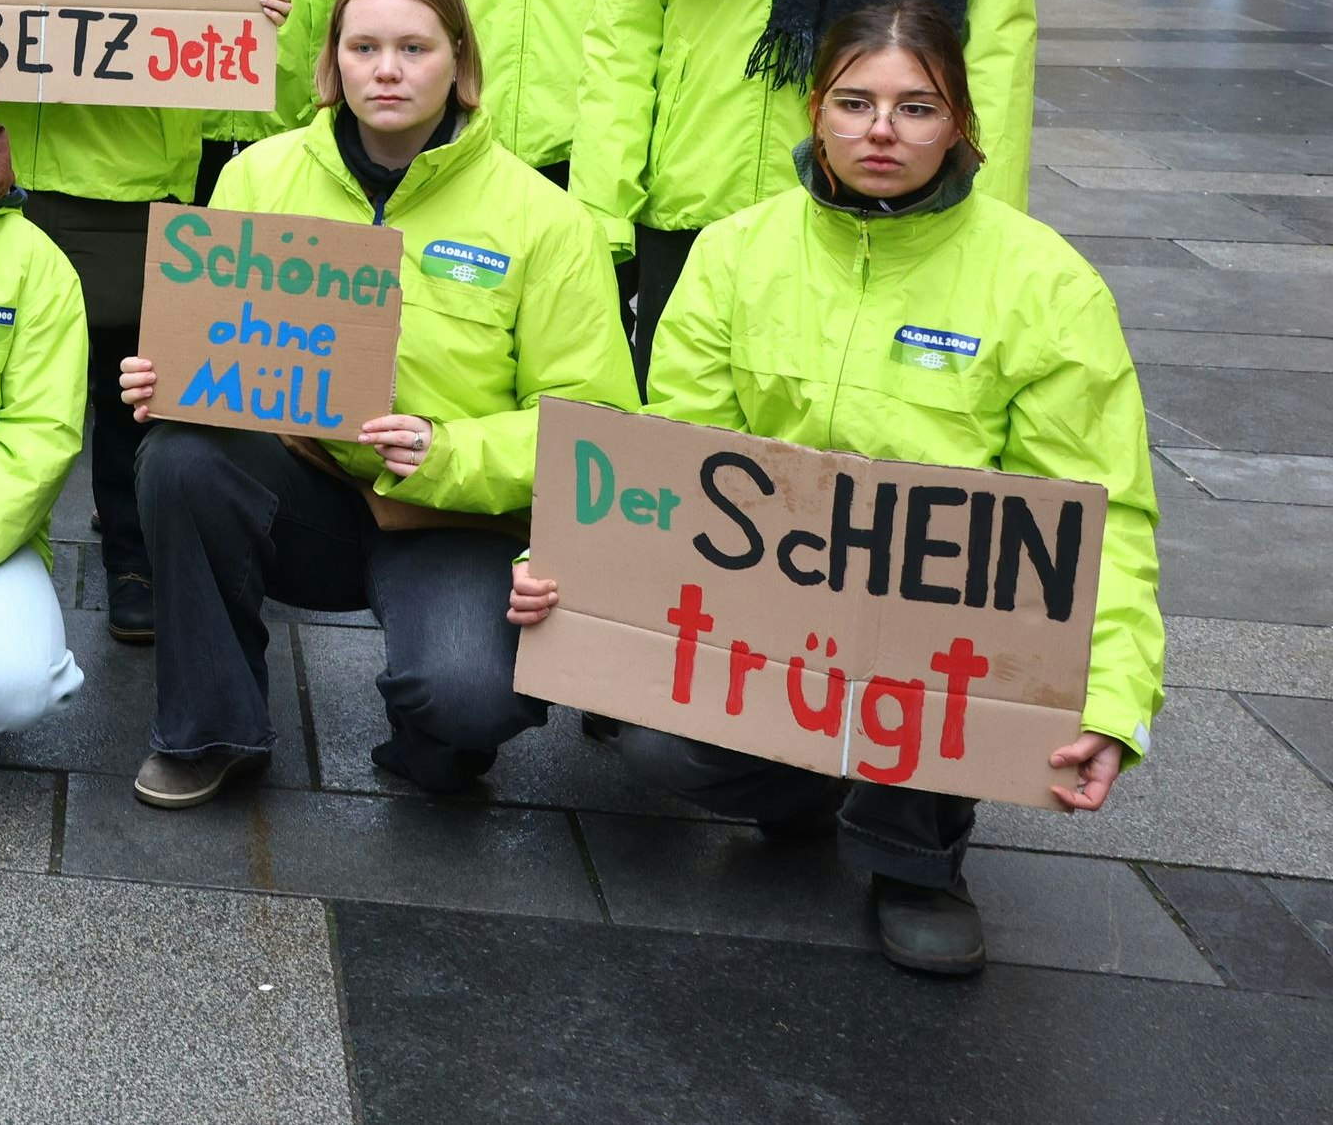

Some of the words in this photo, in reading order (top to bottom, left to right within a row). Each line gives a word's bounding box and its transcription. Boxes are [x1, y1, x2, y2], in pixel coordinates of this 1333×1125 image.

[159, 213, 400, 306] Schöner
[433, 244, 474, 260] GLOBAL
[476, 254, 505, 269] 2000
[207, 300, 336, 356] ohne
[901, 329, 945, 345] GLOBAL
[944, 337, 976, 351] 2000
[178, 357, 343, 428] Müll
[574, 439, 681, 531] Der
[666, 583, 989, 786] trügt
